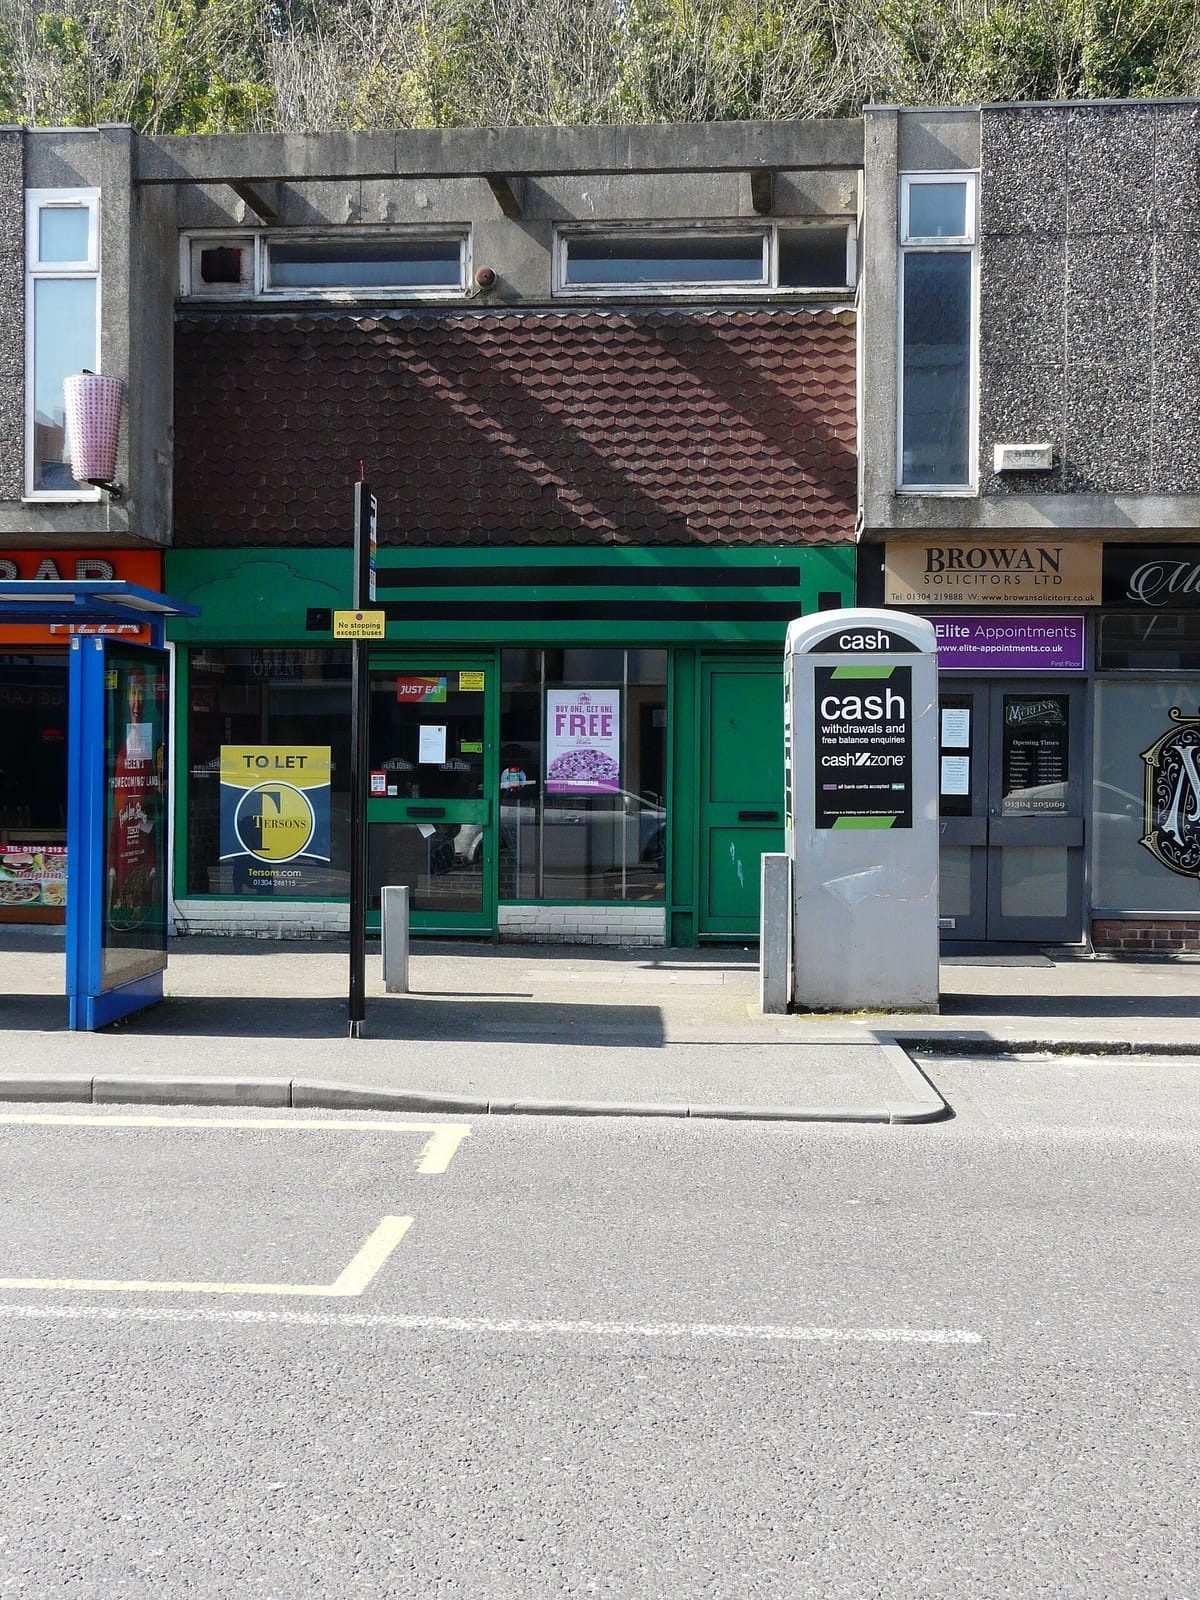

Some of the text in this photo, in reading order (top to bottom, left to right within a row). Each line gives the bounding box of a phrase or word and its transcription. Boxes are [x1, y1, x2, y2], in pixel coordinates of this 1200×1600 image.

[924, 547, 1063, 573] BROWAN
[924, 574, 1063, 585] SOLICITORS LTD
[891, 592, 1095, 602] Tel: 01304 219888 W: www.browansolicitors.co.uk
[350, 622, 381, 630] stopping
[935, 624, 1077, 640] Elite Appointments
[839, 630, 890, 650] cash
[938, 644, 1063, 653] www.elite-appointments.co.uk
[400, 685, 443, 695] JUST EAT
[555, 705, 569, 713] BUY
[586, 705, 598, 713] GET
[600, 705, 613, 713] ONE
[821, 687, 905, 721] cash
[555, 714, 613, 737] FREE
[821, 723, 905, 734] withdrawals and
[821, 736, 906, 745] free balance enquiries
[1012, 739, 1040, 747] Opening
[243, 755, 269, 769] TO
[274, 755, 308, 769] LET
[1004, 801, 1065, 809] 01304 205069
[252, 815, 306, 829] TERSONS
[248, 868, 302, 878] Tersons.com
